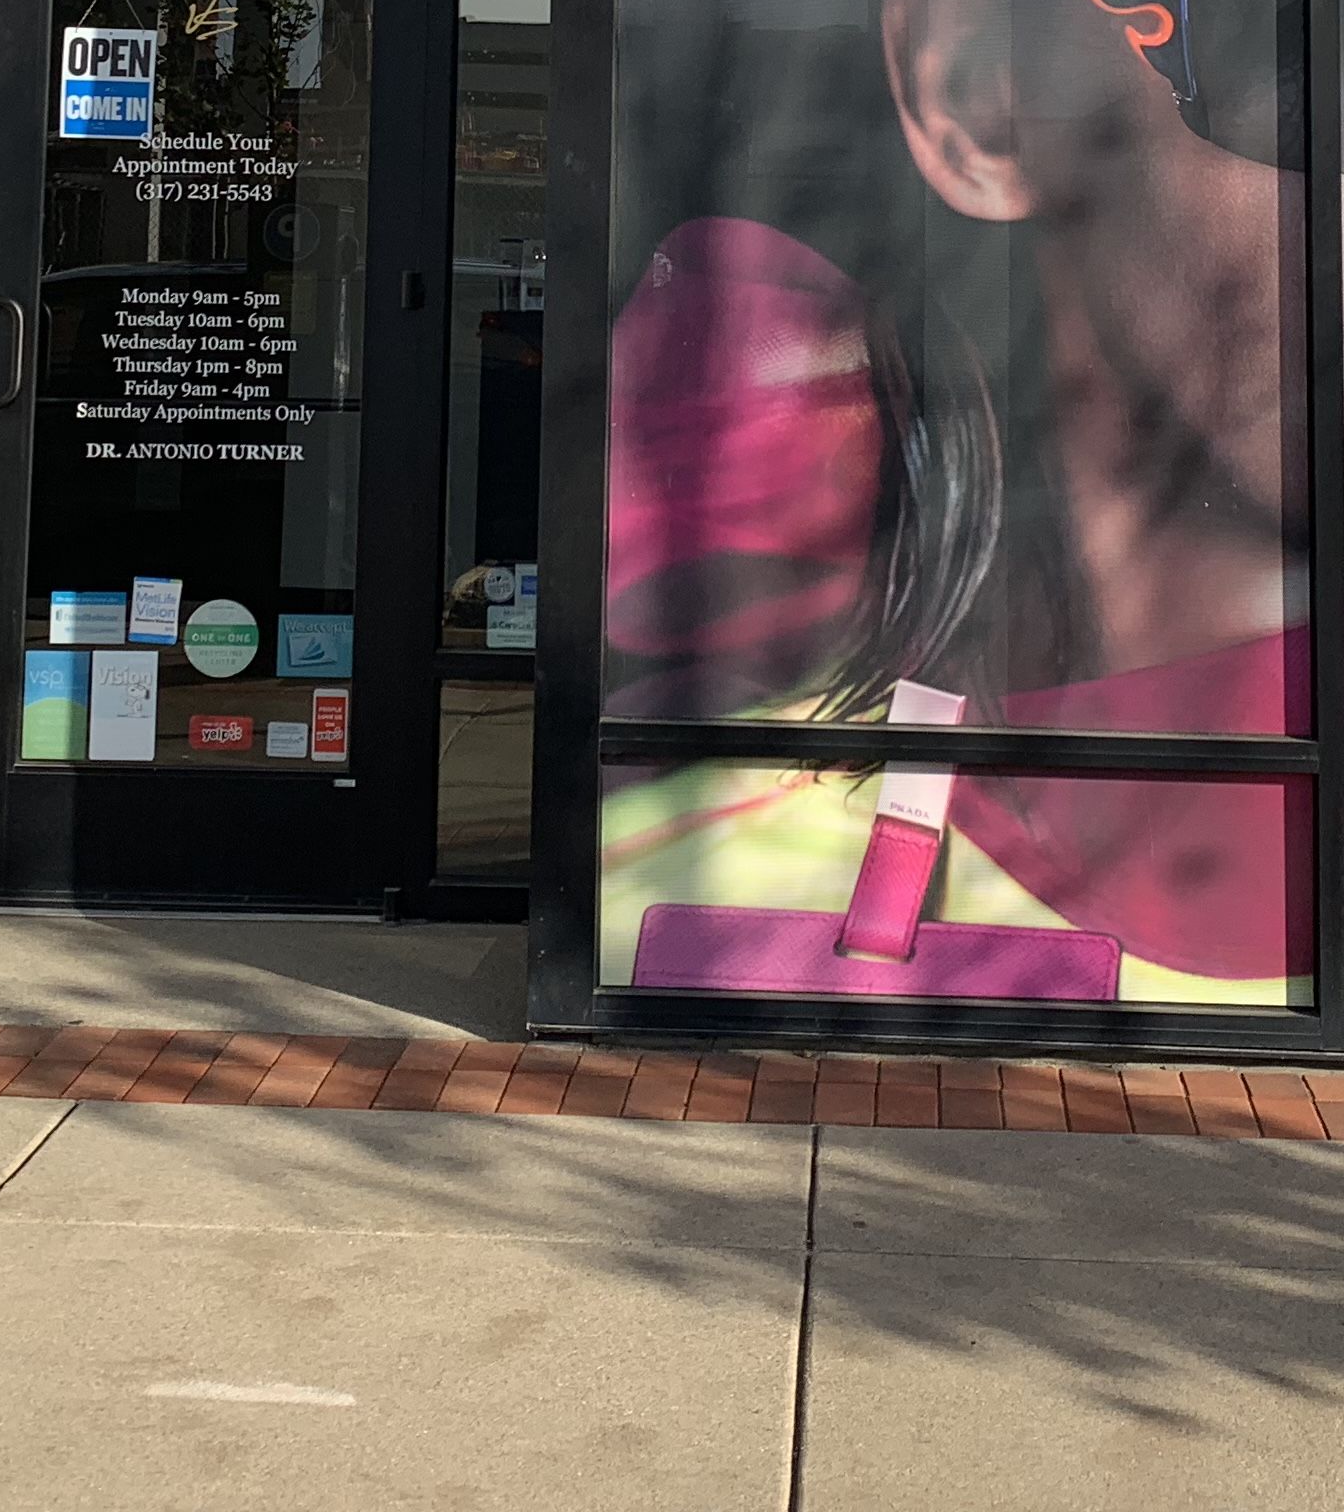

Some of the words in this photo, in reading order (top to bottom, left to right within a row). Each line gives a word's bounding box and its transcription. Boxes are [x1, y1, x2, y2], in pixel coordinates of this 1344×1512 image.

[68, 37, 152, 77] OPEN
[67, 95, 123, 120] COME
[126, 97, 146, 121] IN
[139, 133, 223, 150] Schedule
[227, 134, 273, 151] Your
[112, 156, 236, 177] Appointment
[240, 157, 298, 179] Today
[136, 181, 182, 201] (317)
[187, 184, 273, 201] 231-5543
[121, 288, 189, 307] Monday
[192, 291, 228, 305] 9am
[244, 291, 280, 308] 5pm
[115, 311, 184, 330] Tuesday
[188, 313, 232, 327] 10am
[248, 313, 285, 332] 6pm
[102, 334, 196, 353] Wednesday
[200, 337, 244, 351] 10am
[260, 336, 297, 355] 6pm
[113, 357, 191, 376] Thursday
[196, 359, 229, 376] 1pm
[245, 359, 283, 377] 8pm
[124, 380, 178, 399] Friday
[181, 382, 217, 397] 9am
[232, 383, 270, 400] 4pm
[76, 402, 151, 422] Saturday
[153, 404, 271, 423] Appointments
[275, 405, 315, 425] Only
[86, 443, 121, 459] DR.
[126, 444, 213, 460] ANTONIO
[216, 445, 304, 460] TURNER
[136, 603, 175, 617] Vision
[192, 633, 215, 642] ONE
[228, 633, 251, 642] ONE
[29, 670, 64, 689] vsp
[202, 727, 230, 743] yelp
